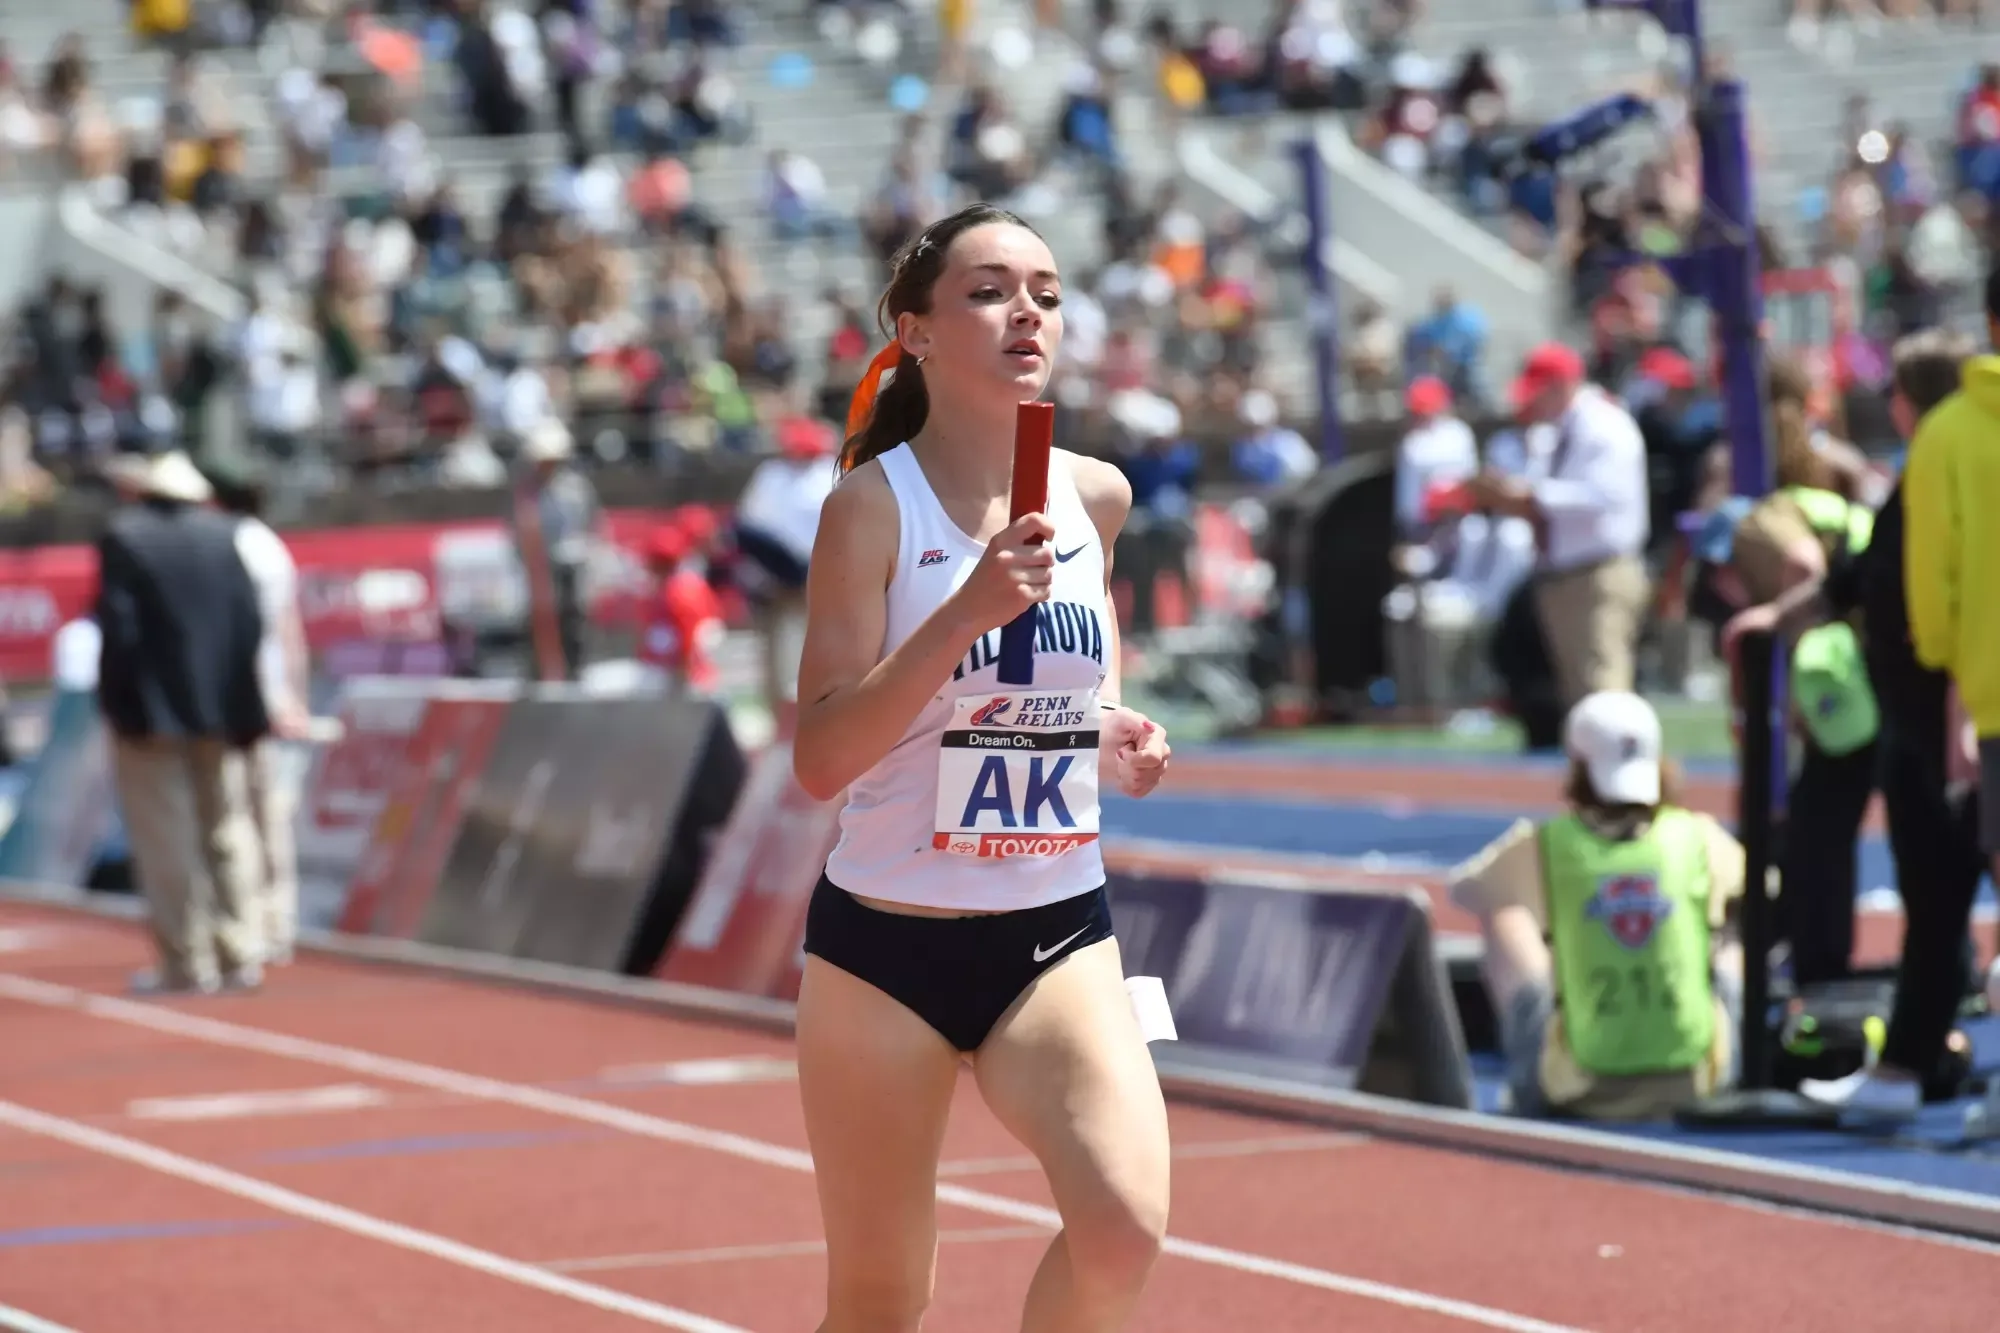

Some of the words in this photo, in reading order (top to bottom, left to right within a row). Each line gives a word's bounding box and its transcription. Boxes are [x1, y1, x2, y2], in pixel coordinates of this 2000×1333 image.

[919, 556, 950, 565] EAST
[922, 549, 944, 558] BIG
[1020, 696, 1072, 712] PENN
[1013, 711, 1085, 727] RELAYS
[968, 733, 1011, 747] Dream
[1013, 735, 1036, 748] On.
[960, 755, 1077, 828] AK
